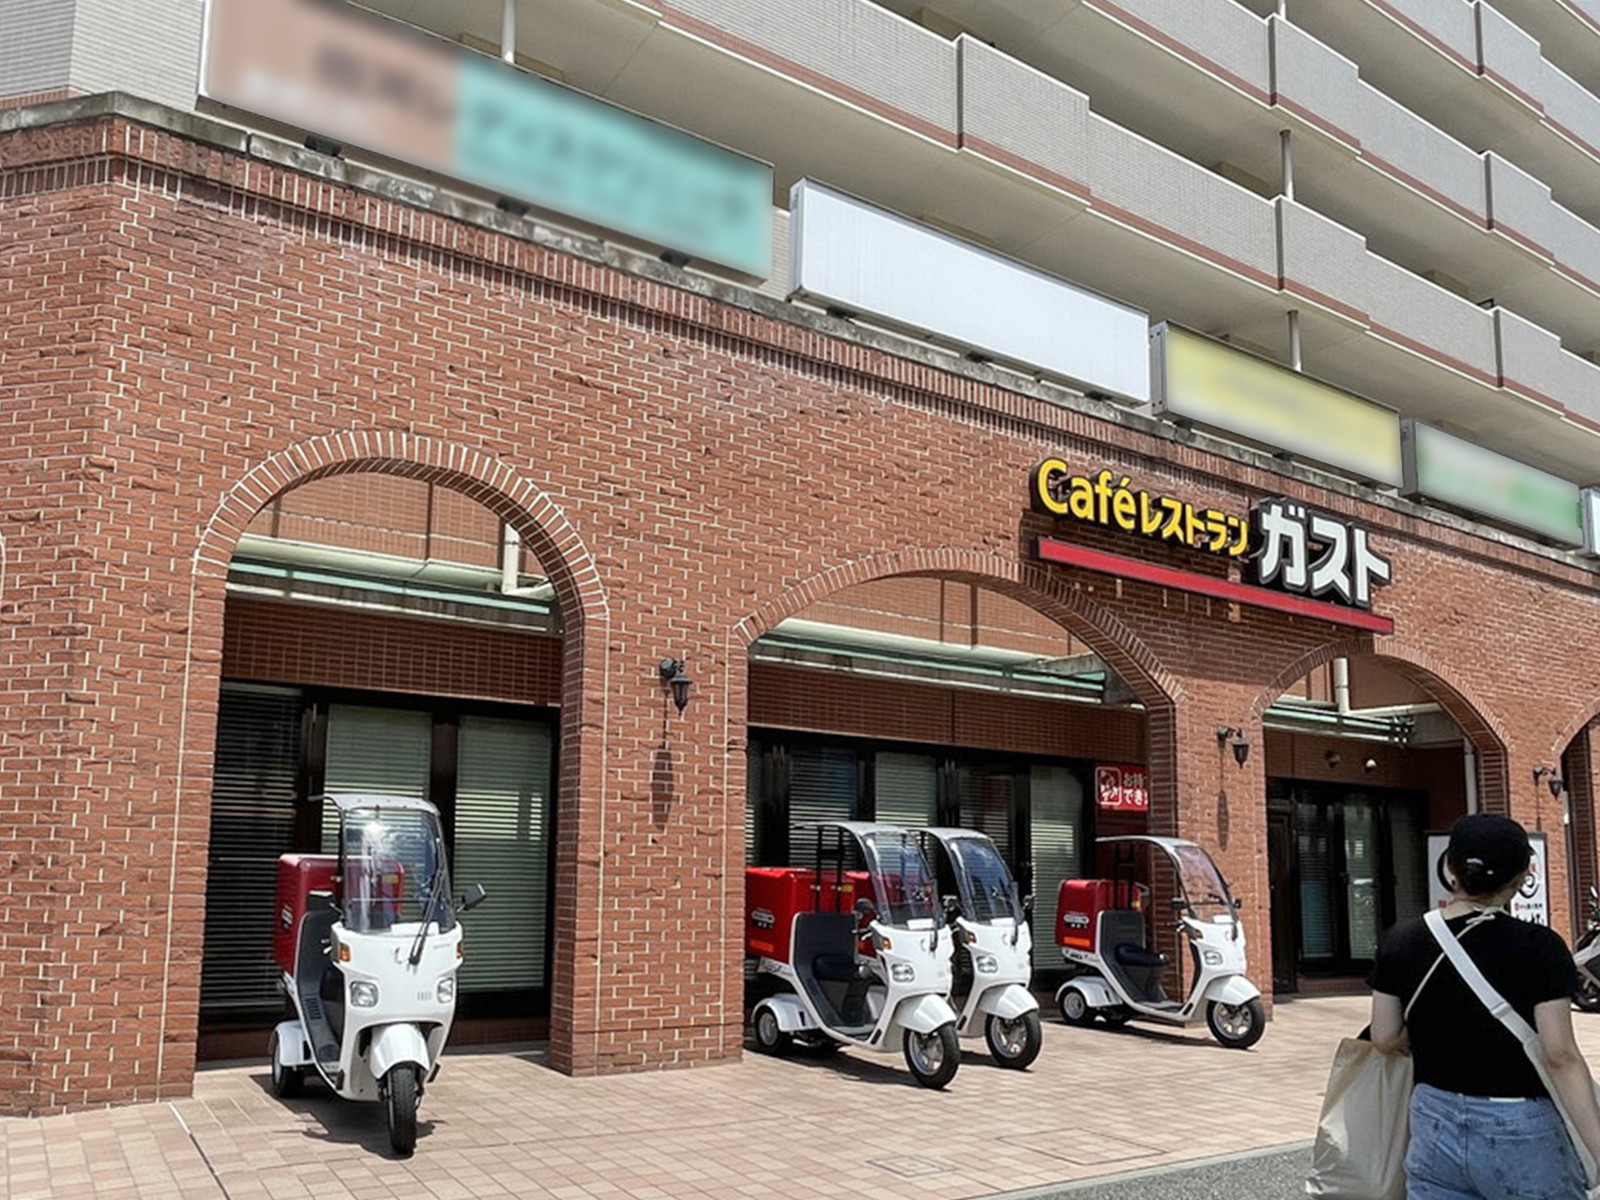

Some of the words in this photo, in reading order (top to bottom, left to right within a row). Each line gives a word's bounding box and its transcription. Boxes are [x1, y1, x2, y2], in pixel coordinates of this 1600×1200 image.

[1261, 503, 1390, 602] ガスト
[1123, 772, 1147, 788] お持
